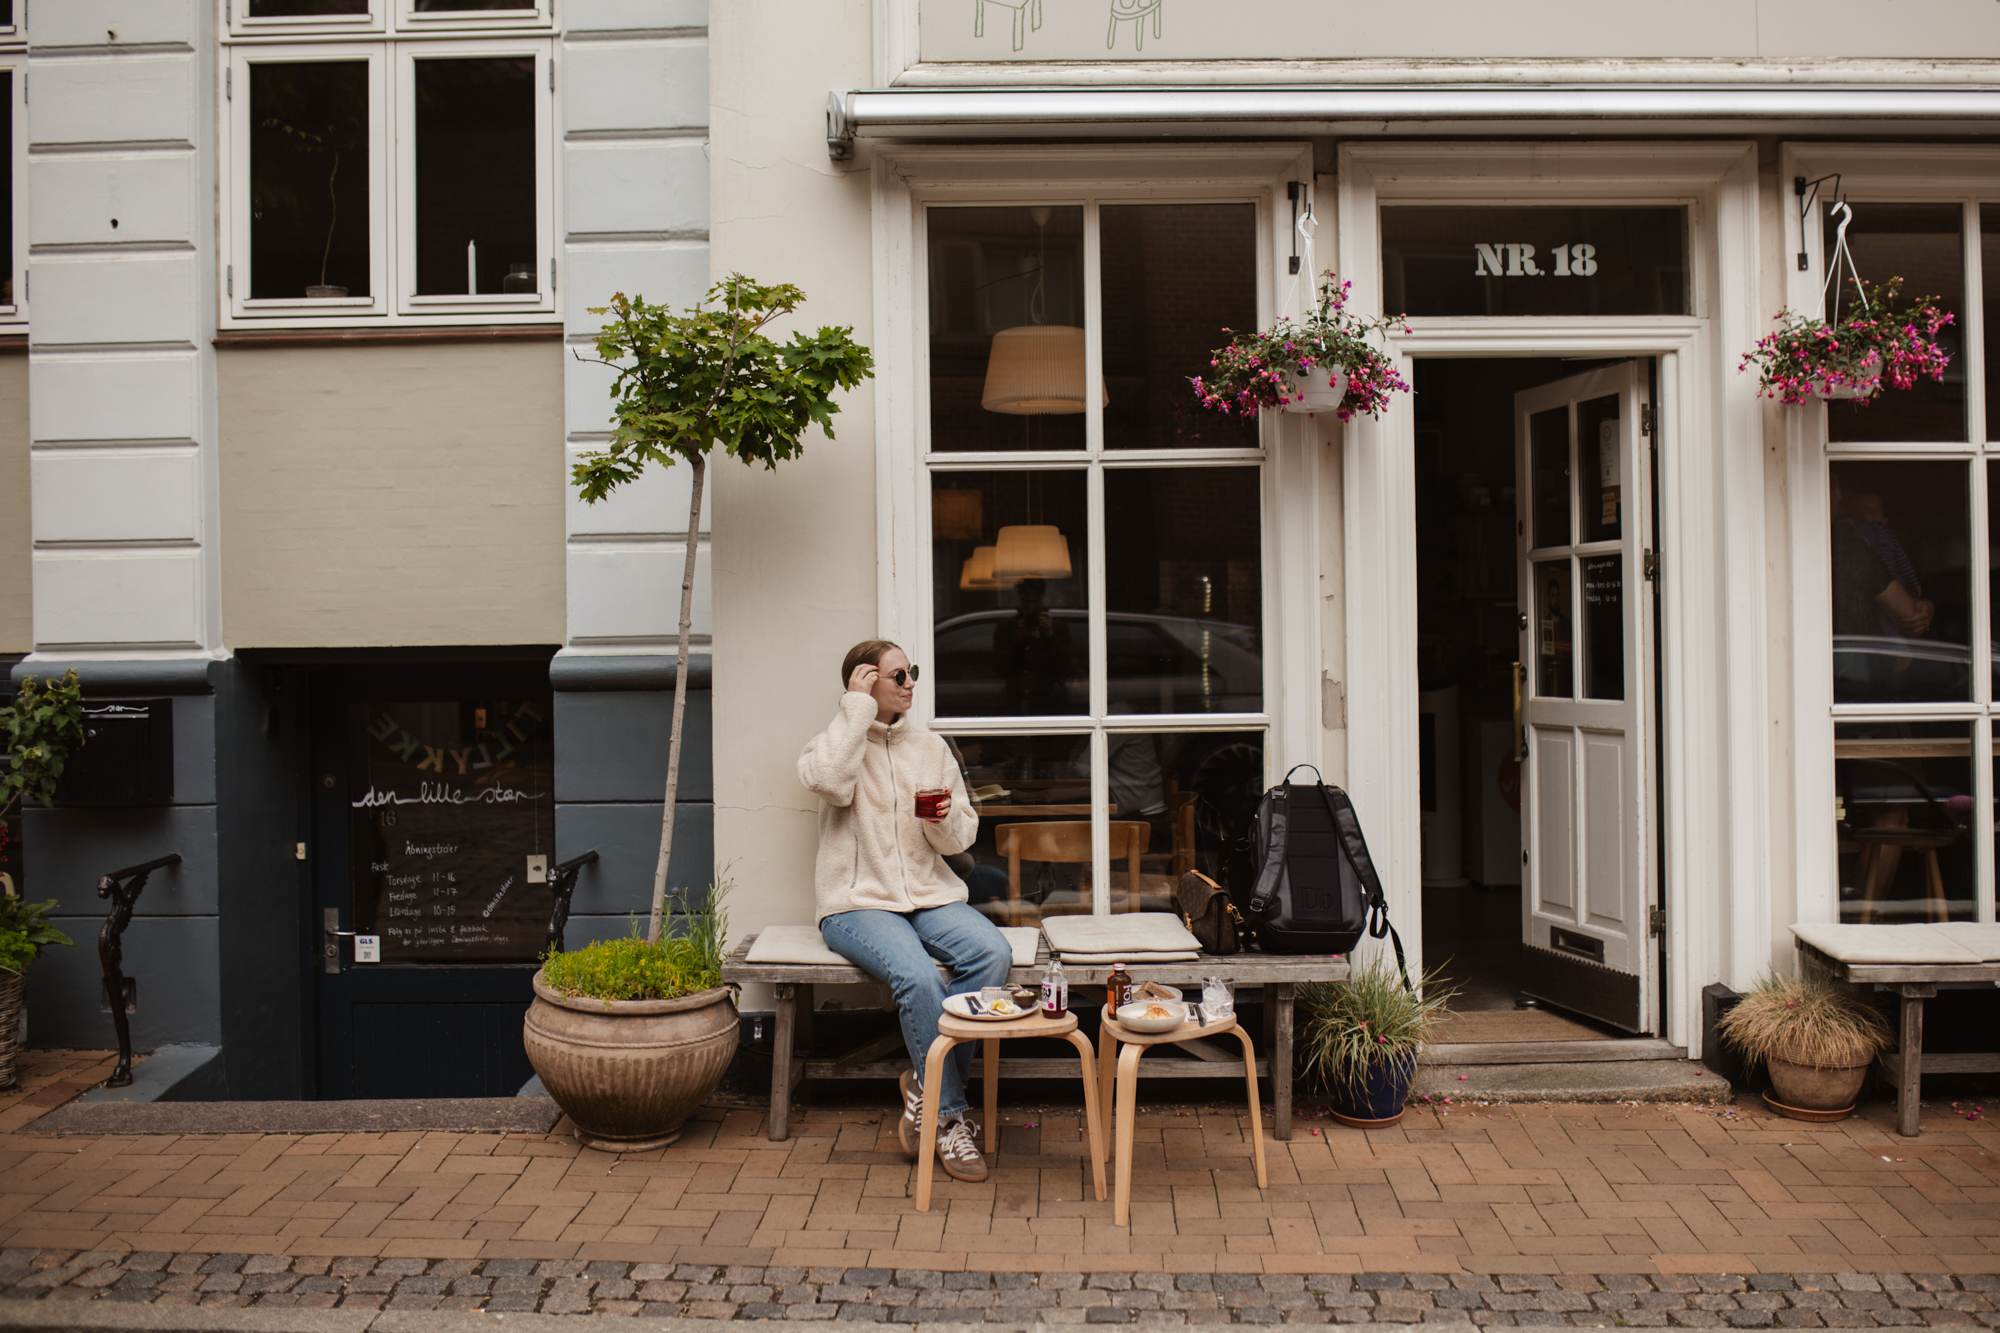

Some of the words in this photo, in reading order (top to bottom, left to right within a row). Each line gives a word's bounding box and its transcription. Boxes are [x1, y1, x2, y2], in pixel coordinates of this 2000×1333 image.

[1475, 243, 1545, 276] NR.
[1551, 243, 1598, 276] 18
[352, 785, 398, 807] den
[420, 781, 464, 805] lille
[379, 810, 397, 827] 16
[405, 840, 459, 860] Åbningstider
[386, 874, 422, 889] Torsdage
[389, 890, 418, 906] Fredage
[433, 887, 458, 897] 11-17
[433, 905, 456, 916] 10-15
[428, 924, 447, 934] insta
